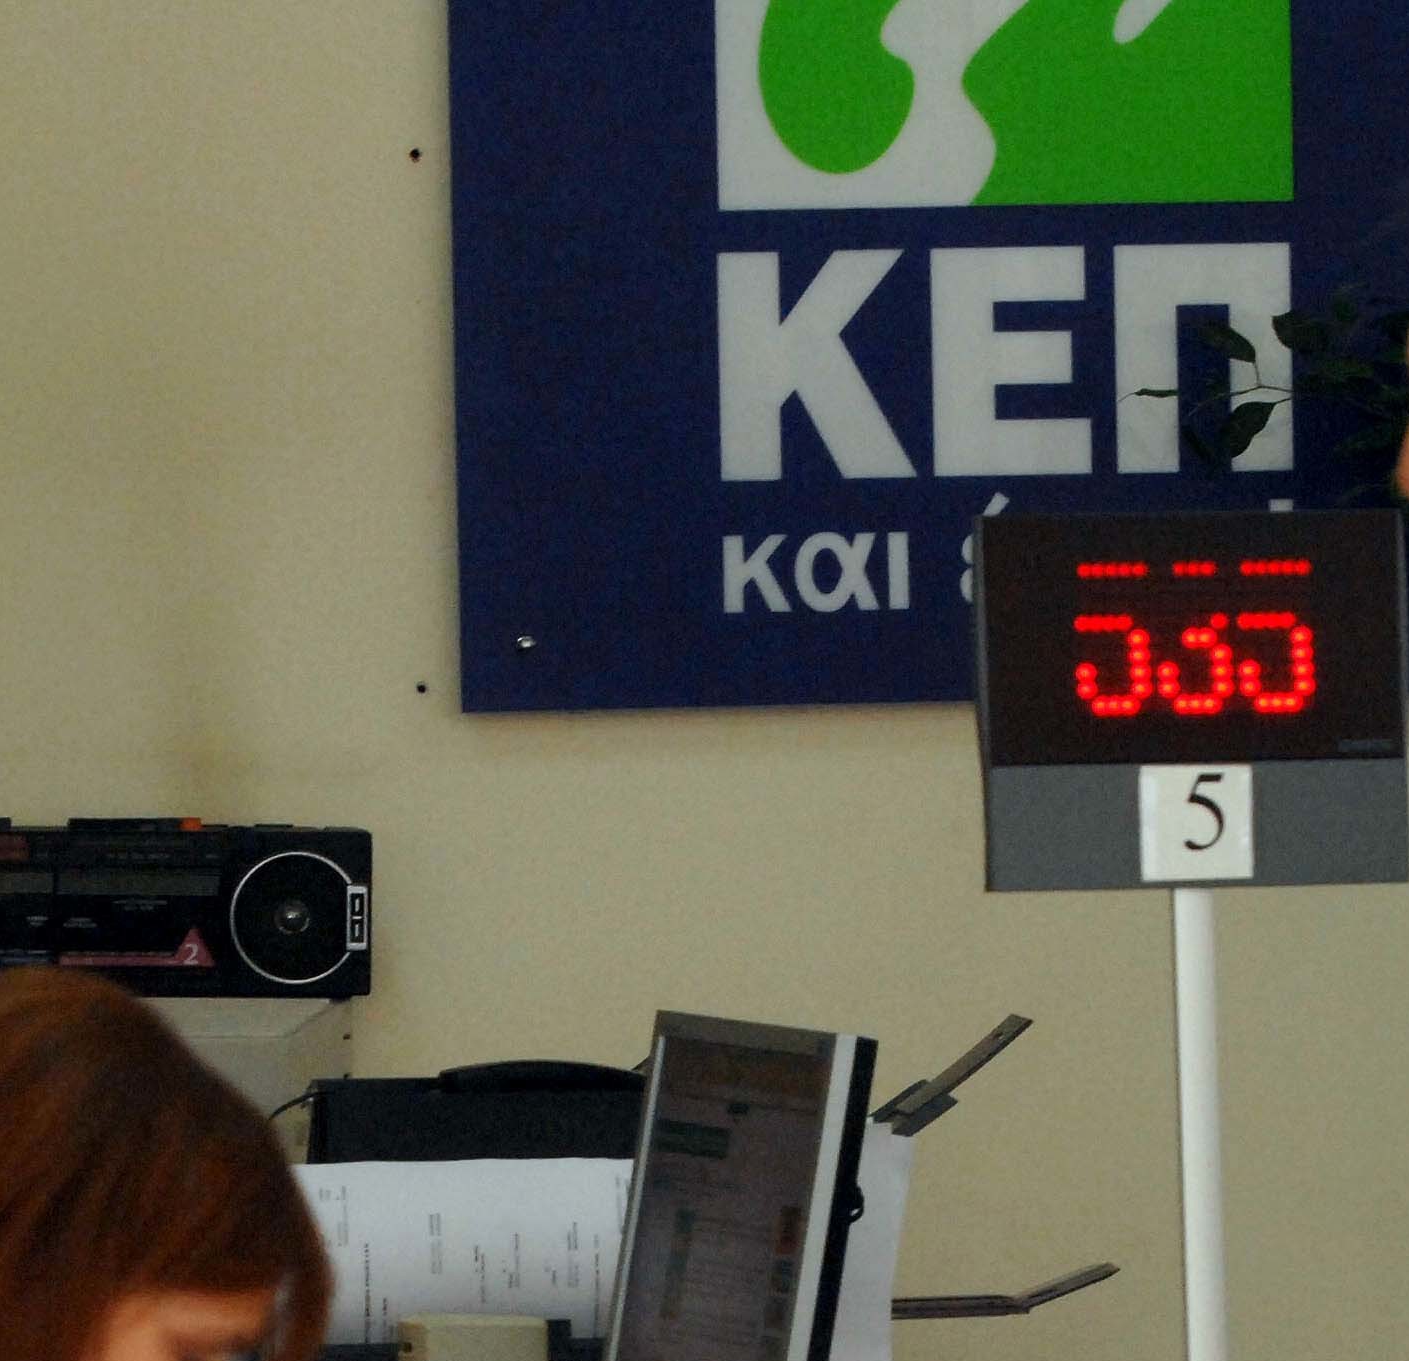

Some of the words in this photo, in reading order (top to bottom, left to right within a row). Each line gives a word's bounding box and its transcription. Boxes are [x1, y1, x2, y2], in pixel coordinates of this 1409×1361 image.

[716, 241, 1293, 481] ΚΕΠ
[722, 530, 910, 614] και
[1184, 773, 1224, 852] 5
